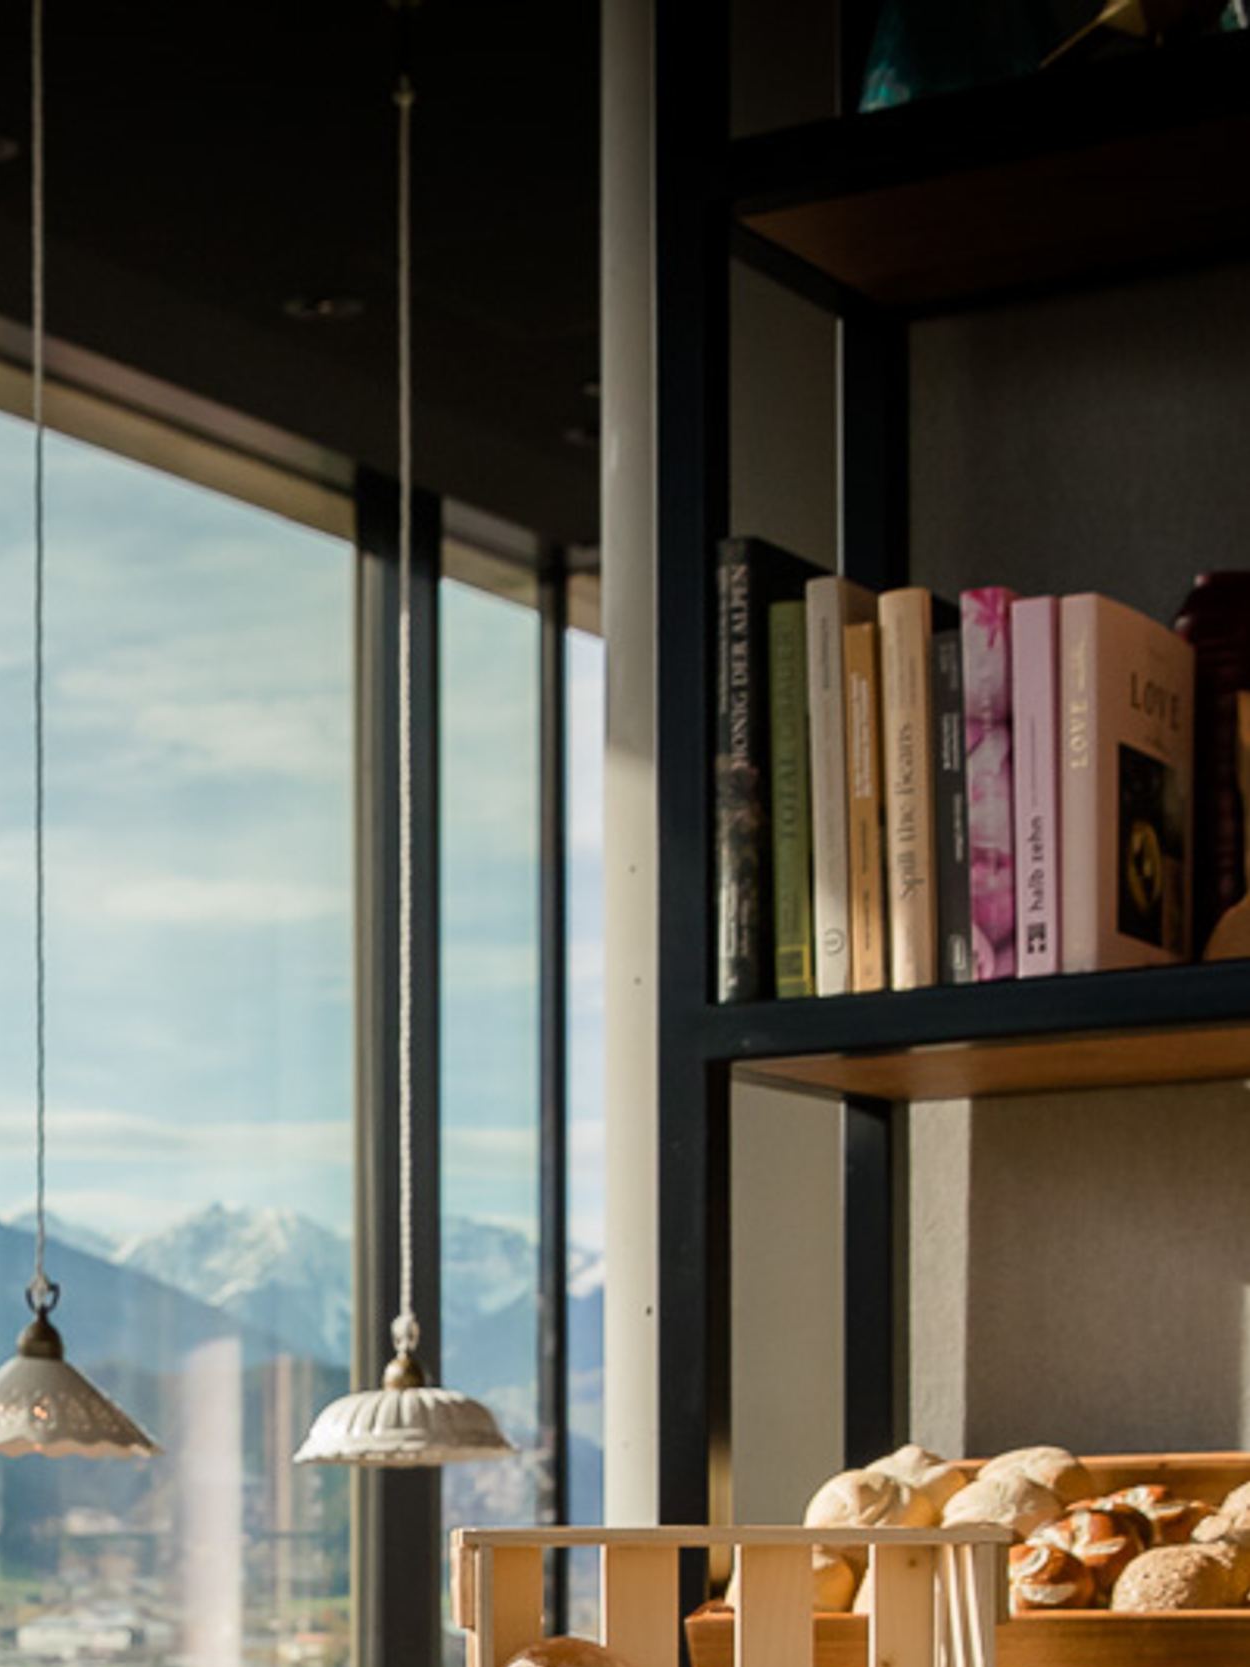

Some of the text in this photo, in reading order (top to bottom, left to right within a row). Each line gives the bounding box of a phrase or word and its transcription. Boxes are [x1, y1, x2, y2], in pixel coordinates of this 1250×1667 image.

[730, 564, 749, 634] ALPEN
[730, 640, 749, 688] DER
[894, 722, 913, 796] Beans
[1070, 699, 1088, 769] LOVE
[778, 754, 798, 841] TOTAL
[896, 803, 916, 846] the
[1028, 815, 1044, 865] zehn
[897, 849, 924, 901] Spill
[1028, 868, 1046, 912] halb
